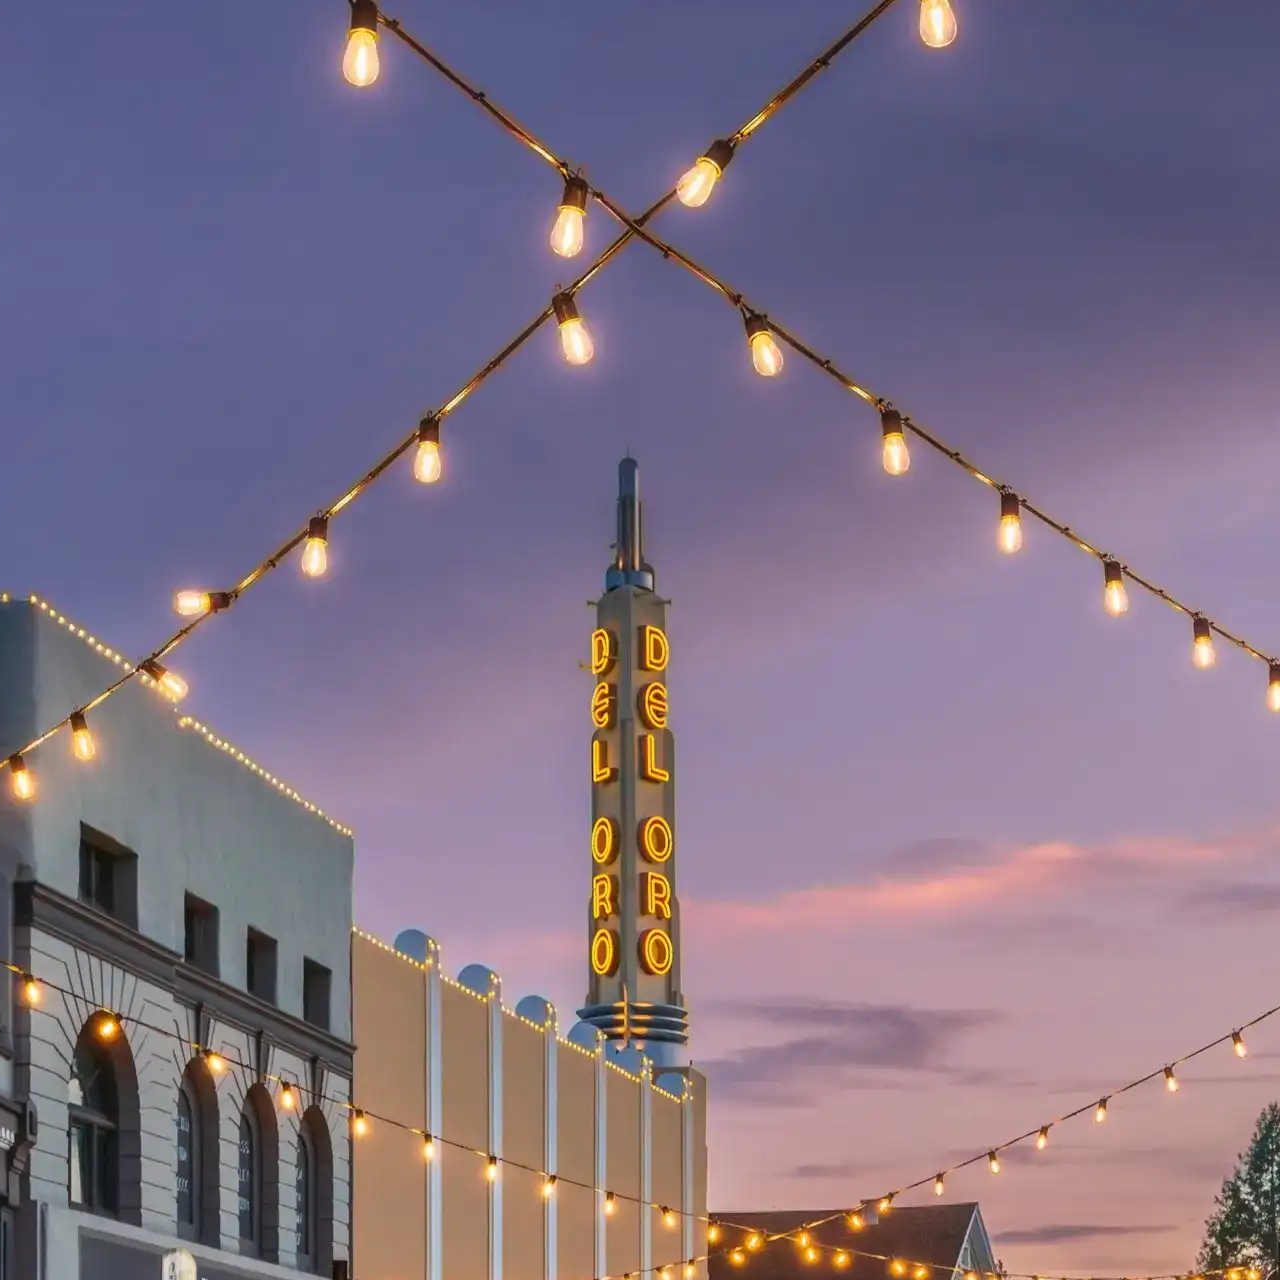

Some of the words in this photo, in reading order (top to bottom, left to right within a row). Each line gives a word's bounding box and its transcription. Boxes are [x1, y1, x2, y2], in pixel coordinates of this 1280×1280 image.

[591, 628, 615, 783] DEL
[641, 624, 671, 784] DEL
[591, 816, 617, 976] ORO
[641, 815, 673, 977] ORO
